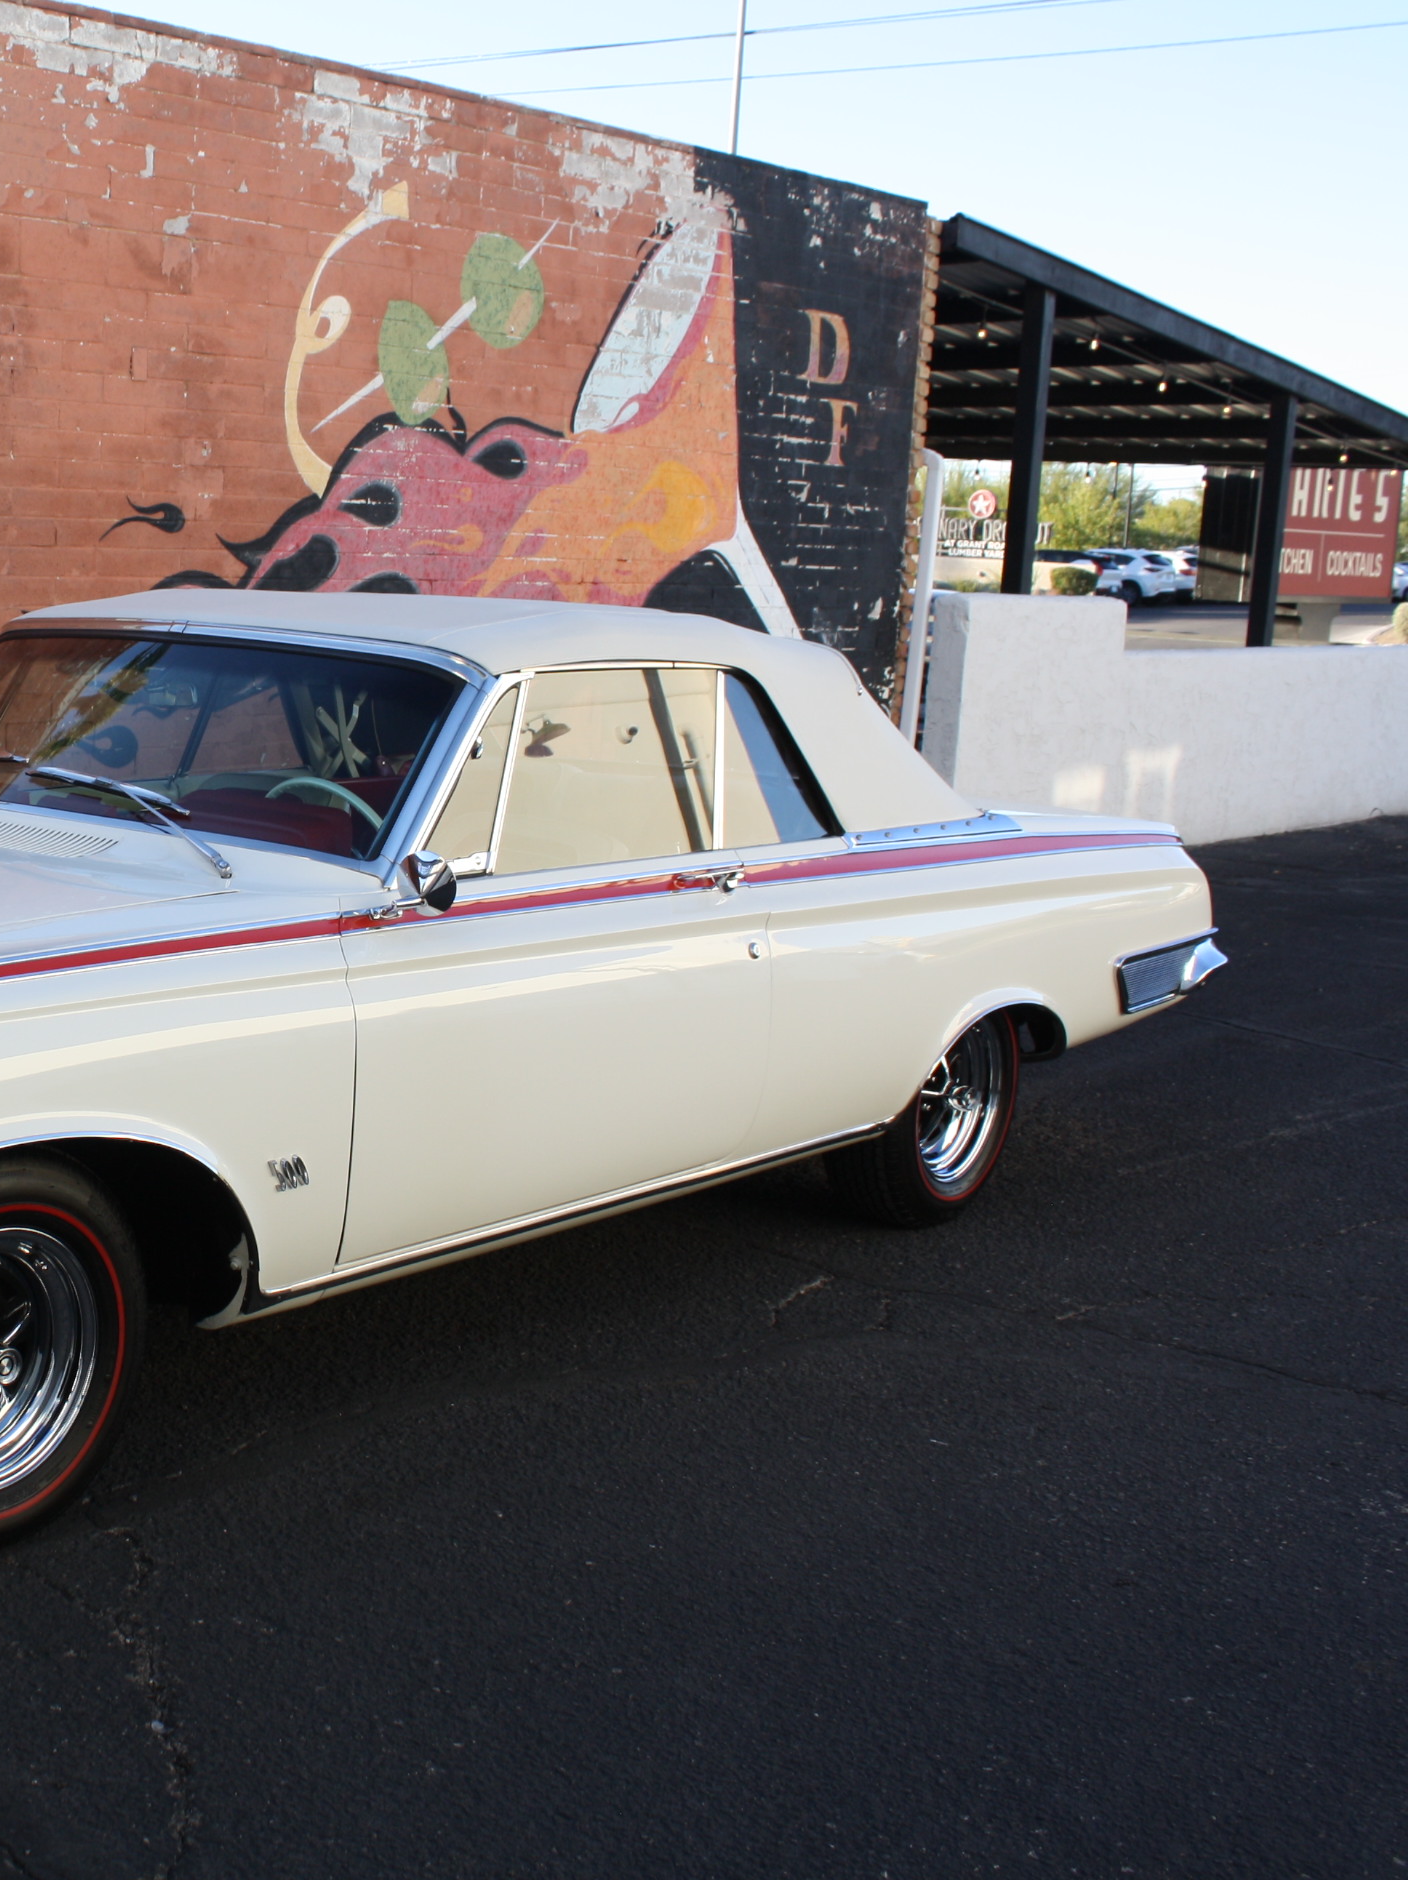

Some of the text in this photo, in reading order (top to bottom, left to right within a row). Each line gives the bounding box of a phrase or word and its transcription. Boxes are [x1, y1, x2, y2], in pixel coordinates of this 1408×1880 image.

[796, 308, 850, 385] D
[822, 398, 859, 467] F
[938, 517, 977, 541] NARY
[944, 540, 954, 548] AT
[956, 540, 986, 549] GRANT
[948, 548, 982, 557] LUMBER
[1326, 550, 1384, 578] COCKTAILS
[267, 1154, 310, 1192] 500
